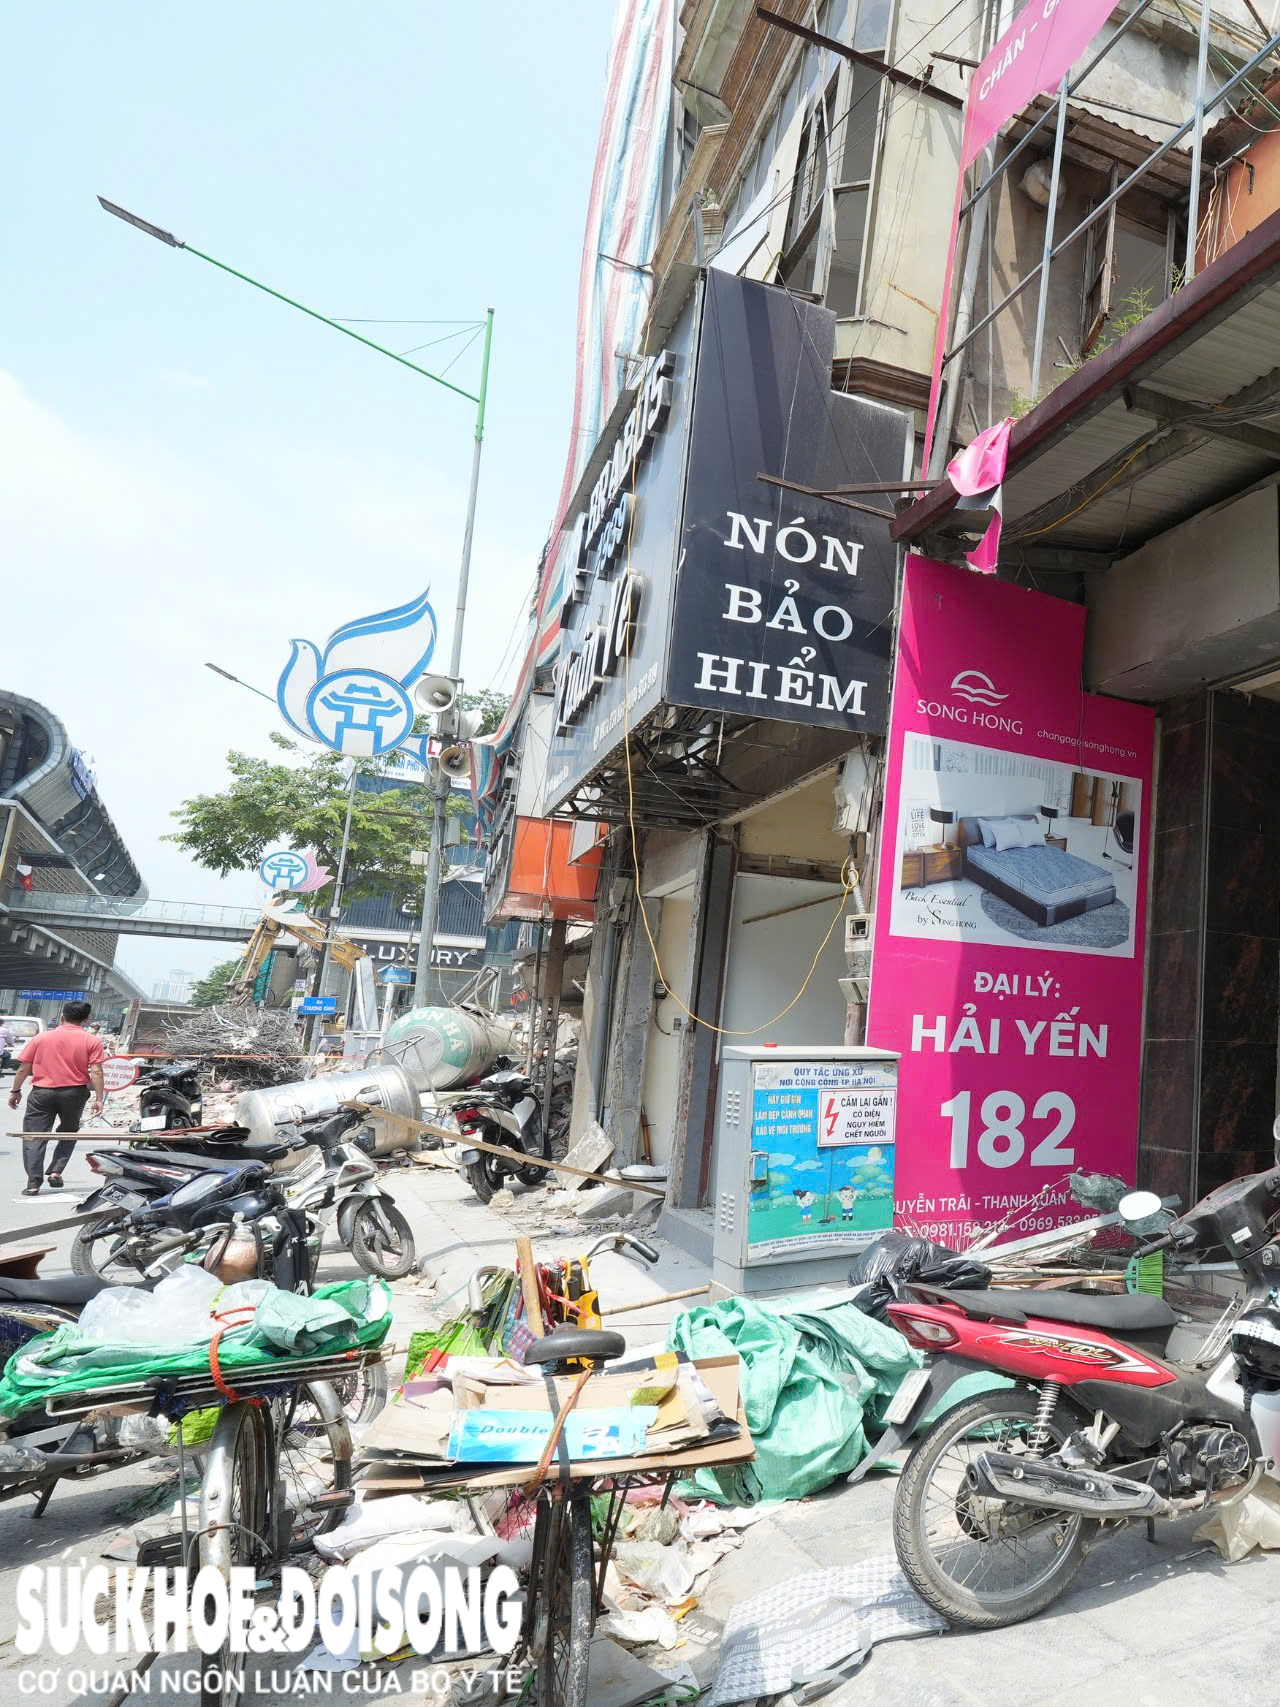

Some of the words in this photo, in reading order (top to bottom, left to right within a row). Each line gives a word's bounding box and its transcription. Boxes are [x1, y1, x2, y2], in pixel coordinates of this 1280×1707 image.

[979, 30, 1027, 101] CHĂN
[1043, 0, 1060, 20] G
[724, 511, 864, 577] NÓN
[722, 578, 853, 642] BẢO
[694, 646, 867, 715] HIỂM
[916, 699, 968, 724] SONG
[971, 711, 1024, 736] HONG
[974, 971, 1019, 1001] ĐẠI
[1025, 970, 1061, 999] LÝ:
[911, 1002, 1000, 1054] HẢI
[1015, 1006, 1108, 1058] YẾN
[793, 1068, 811, 1076] QUY
[846, 1121, 866, 1129] NGUY
[940, 1090, 1076, 1169] 182
[939, 1194, 971, 1212] TRÃI
[982, 1195, 1028, 1209] THANH
[480, 1425, 549, 1435] Double
